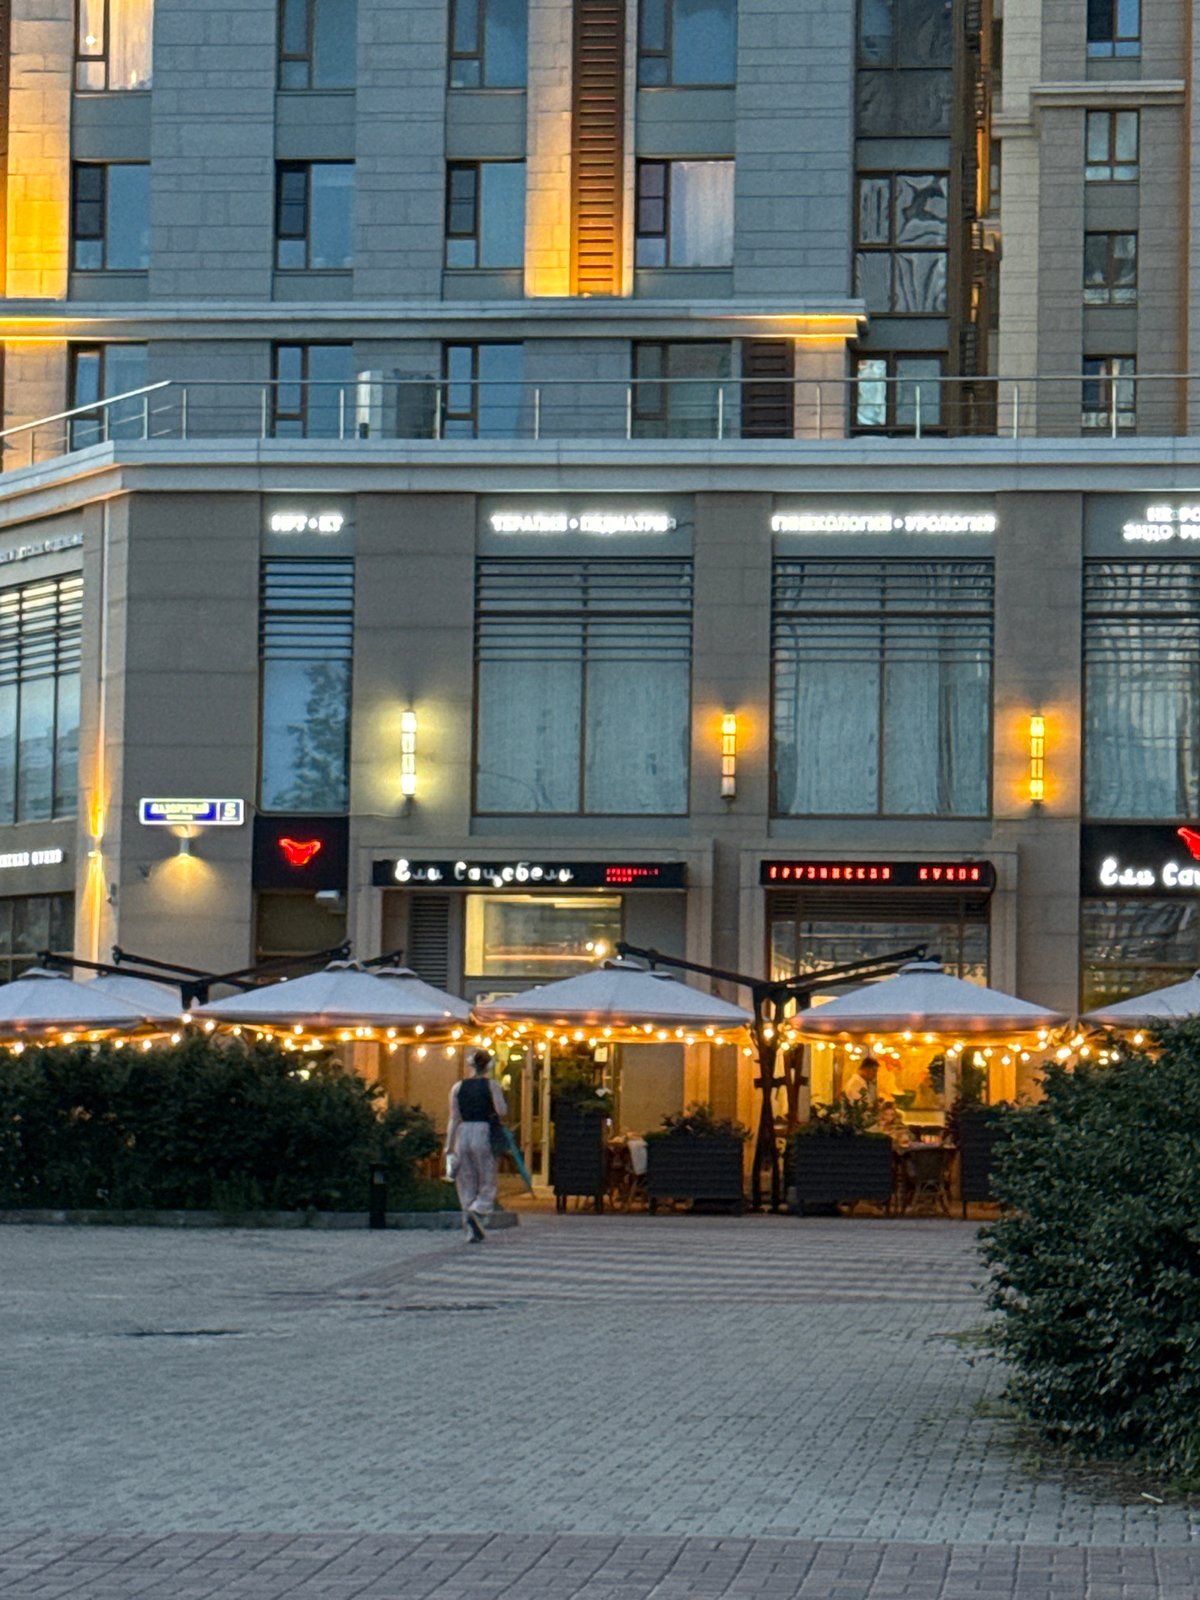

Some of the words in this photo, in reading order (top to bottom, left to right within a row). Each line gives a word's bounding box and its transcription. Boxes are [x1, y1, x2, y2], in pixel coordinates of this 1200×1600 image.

[905, 514, 997, 532] УРОЛОГИЯ
[454, 861, 574, 888] Сацебели
[770, 866, 890, 880] ГРУЗИНСКАЯ
[919, 868, 979, 881] КУХНЯ
